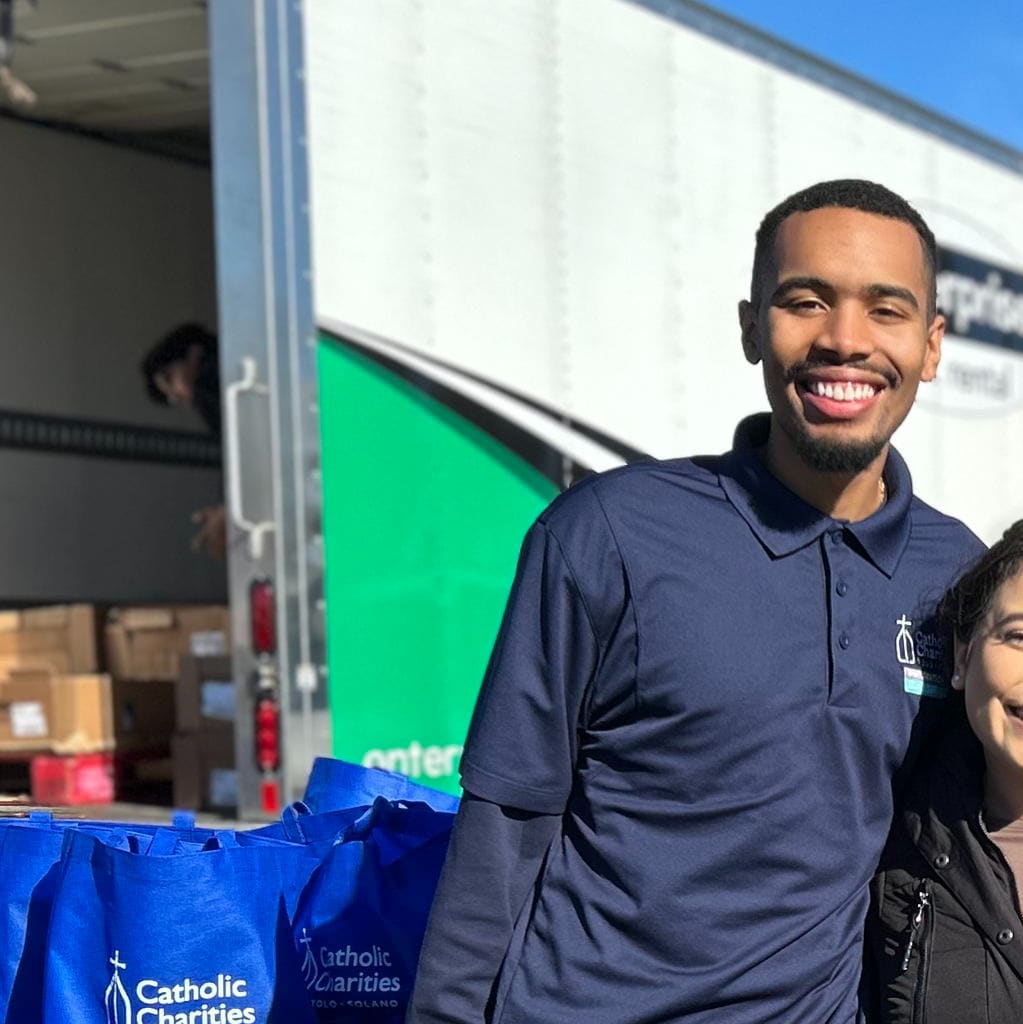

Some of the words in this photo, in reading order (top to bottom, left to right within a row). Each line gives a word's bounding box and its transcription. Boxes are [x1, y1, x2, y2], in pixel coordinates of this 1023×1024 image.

[361, 742, 463, 778] enter
[320, 945, 392, 968] Catholic
[136, 974, 248, 1005] Catholic
